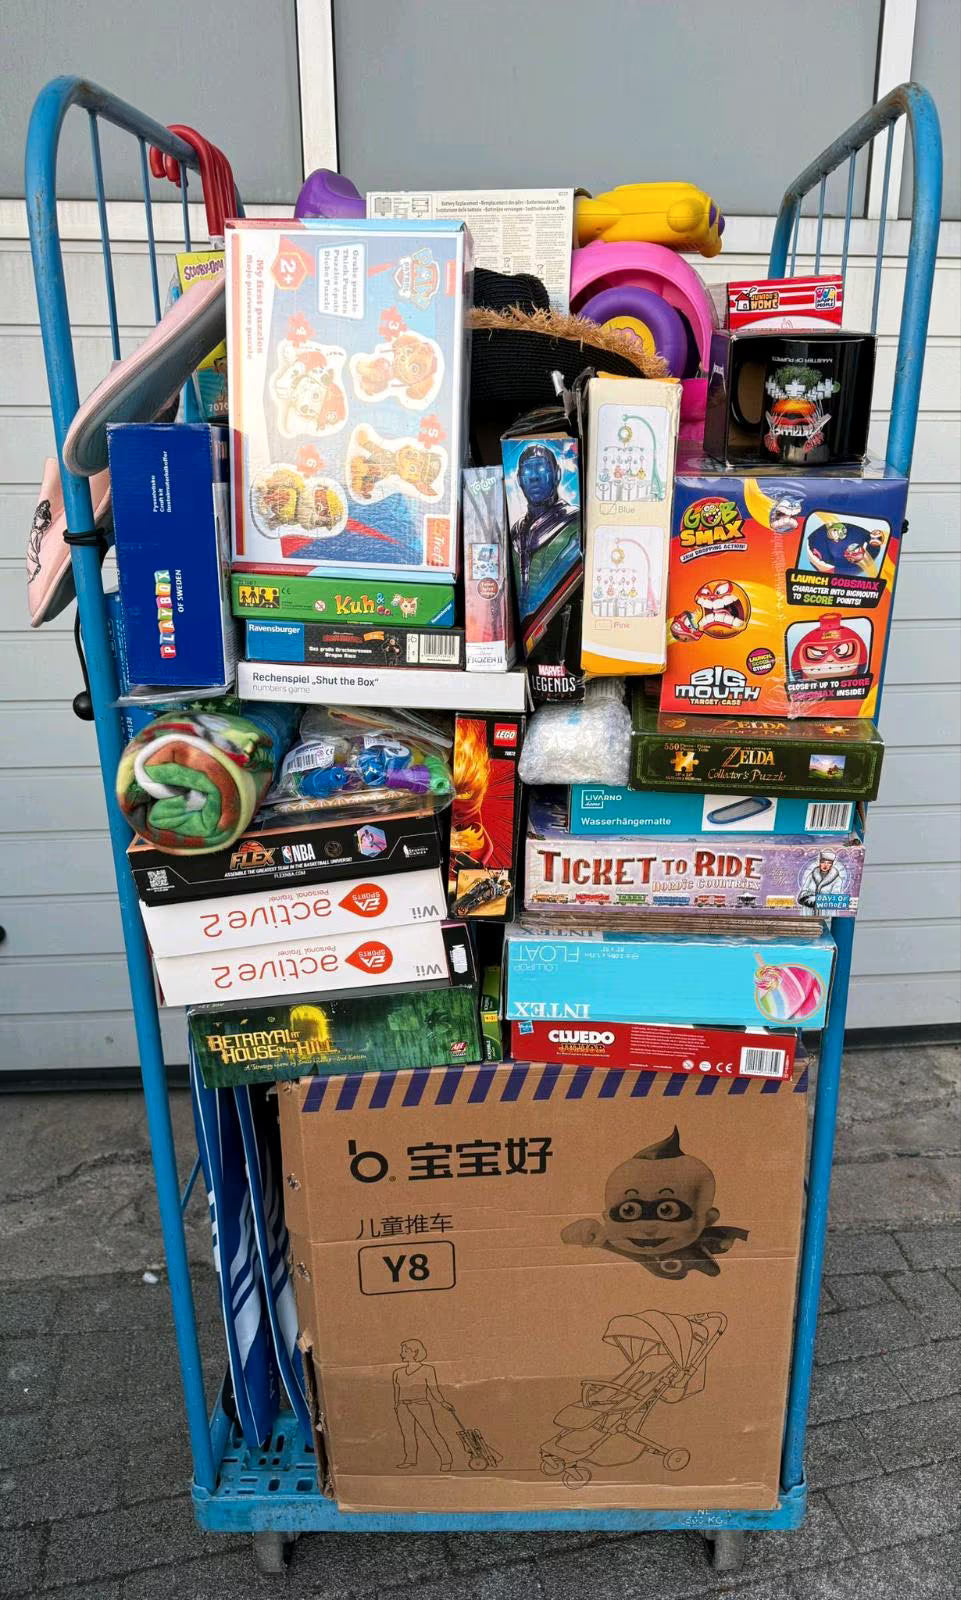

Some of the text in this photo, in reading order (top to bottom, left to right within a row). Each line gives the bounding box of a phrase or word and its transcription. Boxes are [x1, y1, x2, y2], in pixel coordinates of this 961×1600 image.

[281, 258, 298, 285] 2+
[388, 321, 400, 330] 3
[618, 506, 635, 514] Blue
[683, 501, 740, 530] GOB
[680, 519, 745, 546] SMAX
[791, 573, 879, 591] LAUNCH GOBSMAX
[175, 569, 185, 612] OF SWEDEN
[792, 585, 879, 599] CHARACTER INTO BIGMOUTH
[335, 593, 375, 615] Kuh
[803, 594, 834, 605] SCORE
[837, 598, 862, 606] POINTS!
[156, 570, 176, 658] PLAYBOX
[248, 623, 301, 635] Ravensburger
[538, 664, 566, 676] MARVEL
[691, 666, 746, 687] BIG
[252, 672, 379, 687] Rechenspiel „Shut the Box“
[532, 675, 576, 692] LEGENDS
[788, 683, 809, 691] CLOSE
[811, 682, 817, 690] IT
[820, 681, 829, 689] UP
[841, 678, 871, 687] STORE
[252, 684, 311, 695] numbers game
[675, 685, 760, 699] MOUTH
[836, 688, 865, 697] INSIDE!
[690, 698, 741, 706] TARGET CASE
[495, 731, 515, 739] LEGO
[664, 743, 680, 751] 550
[722, 746, 775, 768] ZELDA
[707, 768, 750, 780] Collector's
[751, 768, 787, 783] Puzzle
[580, 817, 672, 827] Wasserhängematte
[230, 843, 317, 871] FLEX NBA
[224, 870, 247, 878] ASSEMBLE
[256, 866, 277, 874] GREATEST
[303, 859, 330, 867] BASKETBALL
[537, 850, 657, 885] TICKET
[662, 859, 688, 876] TO
[695, 850, 763, 880] RIDE
[268, 889, 329, 903] Personal Trainer
[352, 891, 381, 900] SPORTS
[354, 898, 381, 912] EA
[411, 905, 440, 919] Wii
[200, 898, 332, 938] active 2
[277, 945, 336, 957] Personal Trainer
[358, 949, 386, 957] SPORTS
[512, 945, 580, 963] FLOAT
[359, 955, 386, 968] EA
[211, 954, 339, 989] active 2
[415, 963, 443, 977] Wii
[513, 1002, 591, 1019] INTEX
[206, 1029, 297, 1052] BETRAYAL
[547, 1029, 615, 1045] CLUEDO
[222, 1045, 279, 1064] HOUSE
[406, 1137, 553, 1181] 宝宝好
[356, 1212, 454, 1240] 儿童推车
[382, 1253, 430, 1283] Y8
